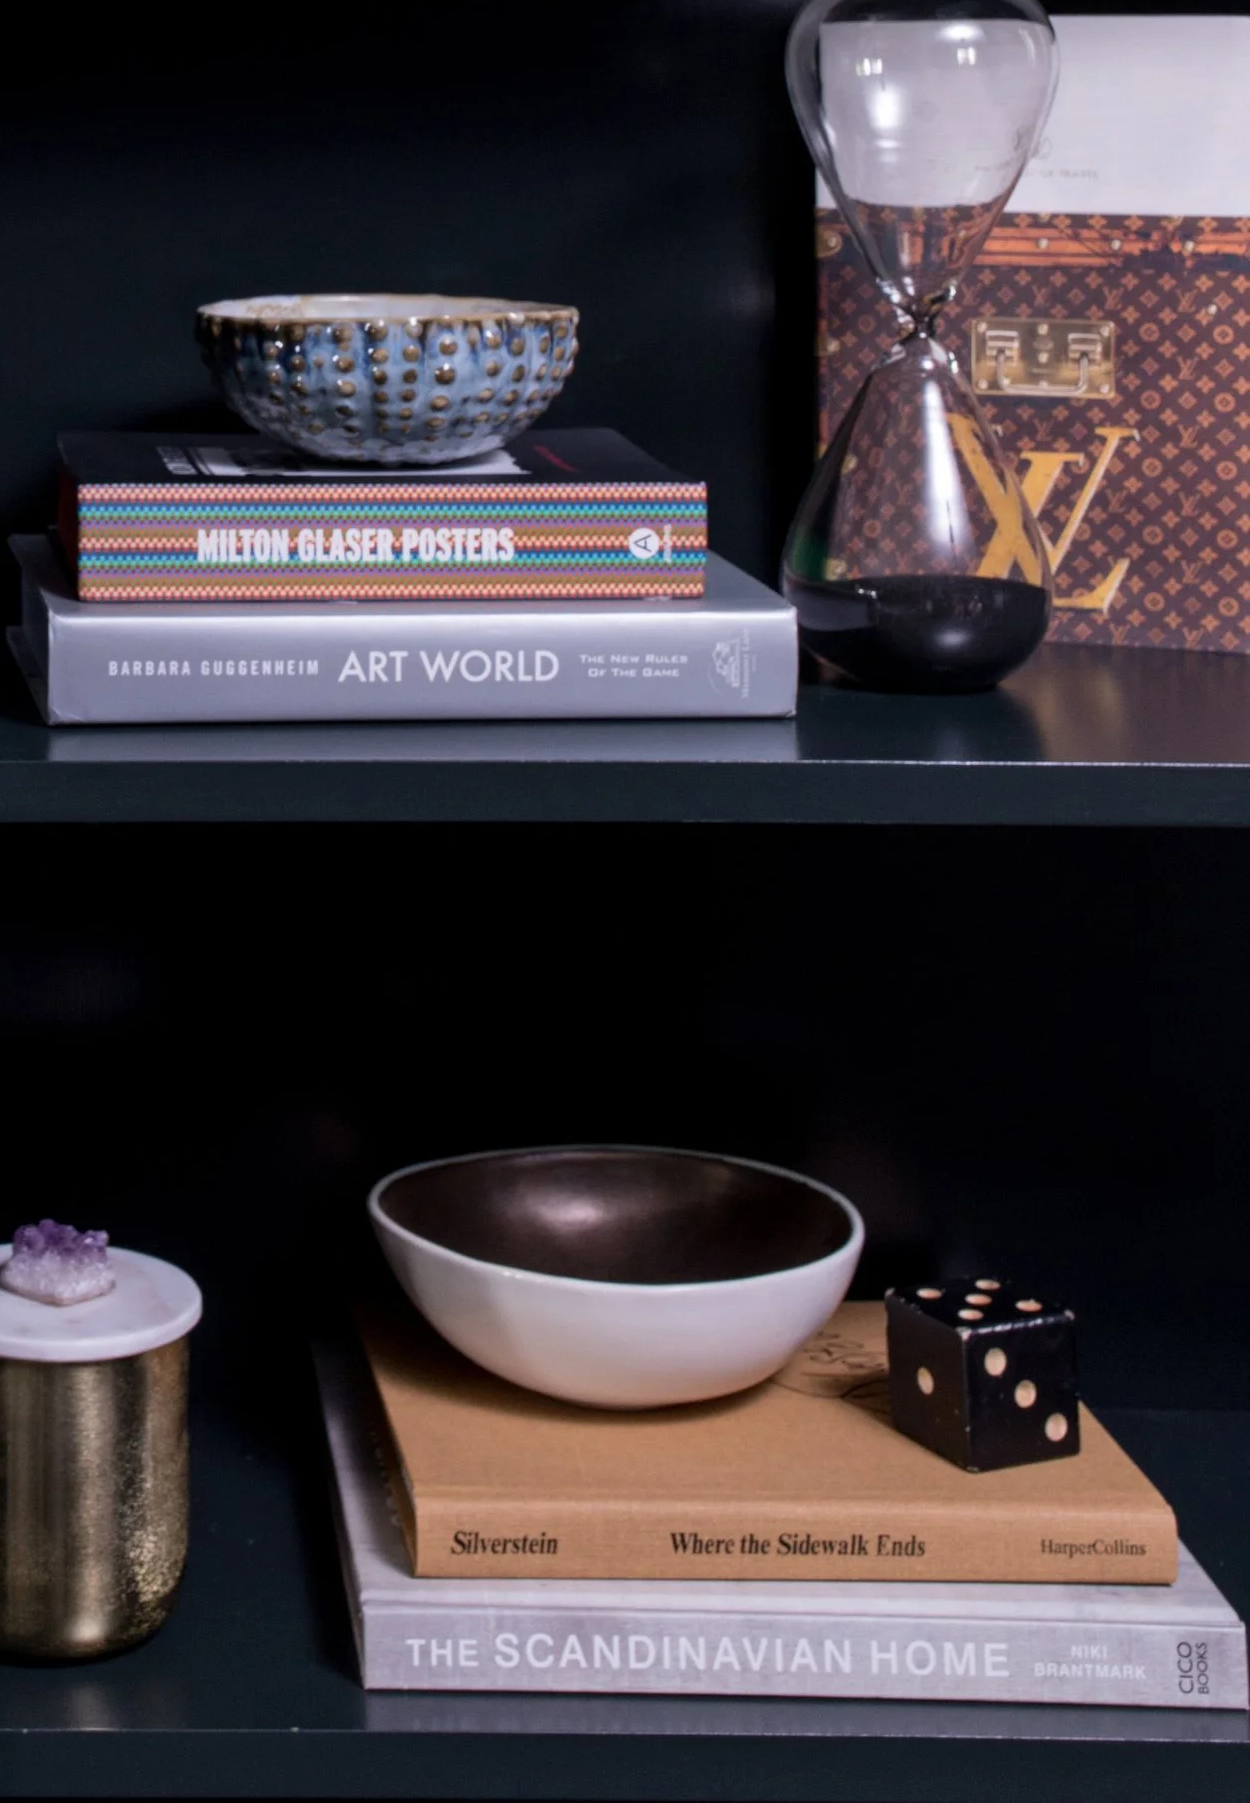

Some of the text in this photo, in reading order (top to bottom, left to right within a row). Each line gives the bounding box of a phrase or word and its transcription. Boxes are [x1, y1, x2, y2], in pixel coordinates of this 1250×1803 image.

[197, 526, 515, 564] MILTON GLASER POSTERS
[108, 659, 320, 677] BARBARA GUGGENHEIM
[337, 649, 560, 683] ART WORLD
[450, 1529, 559, 1556] Silverstein
[670, 1532, 926, 1557] Where the Sidewalk Ends
[1040, 1538, 1147, 1559] HarperCollins
[406, 1632, 1011, 1678] THE SCANDINAVIAN HOME
[1070, 1644, 1108, 1660] NIKI
[1033, 1661, 1147, 1680] BRANTMARK
[1176, 1641, 1194, 1695] CICO
[1195, 1641, 1210, 1695] BOOKS
